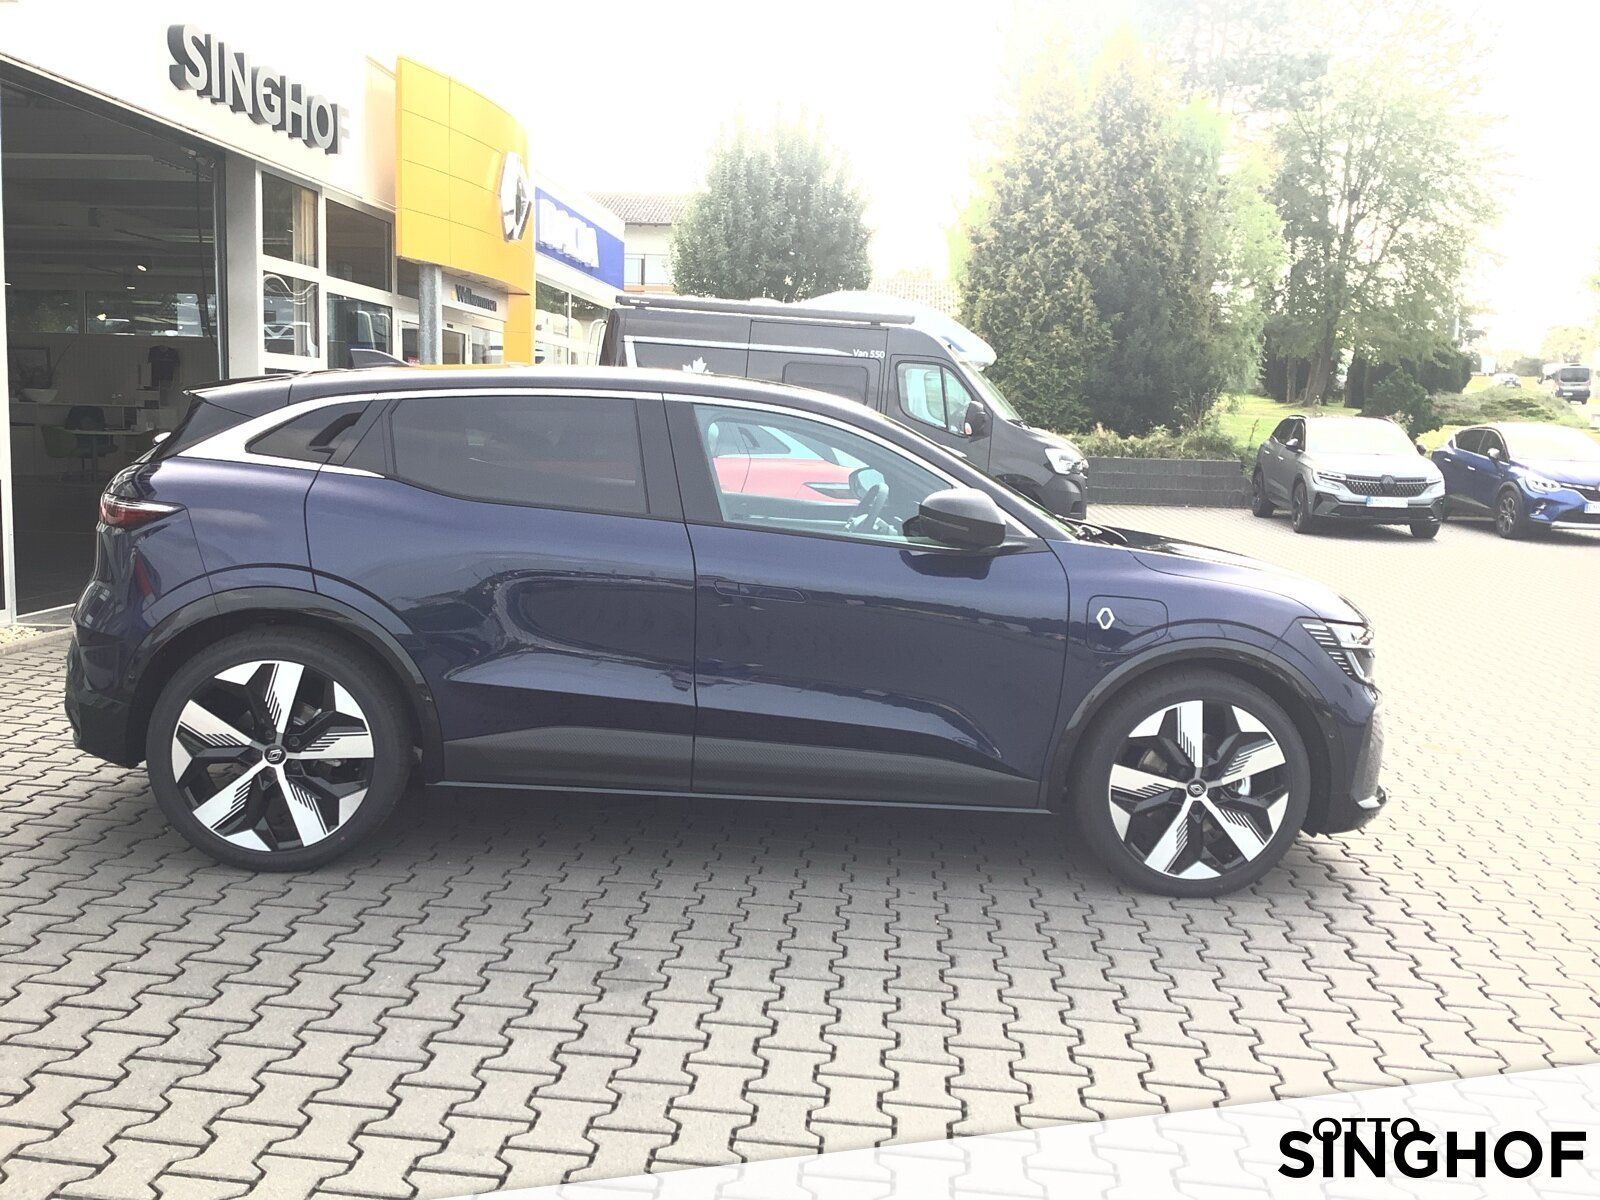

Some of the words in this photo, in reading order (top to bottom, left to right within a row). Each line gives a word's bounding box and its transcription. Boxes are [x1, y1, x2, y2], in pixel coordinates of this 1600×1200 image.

[168, 24, 350, 155] SINGHOF
[853, 349, 868, 357] Van
[870, 350, 885, 358] 550
